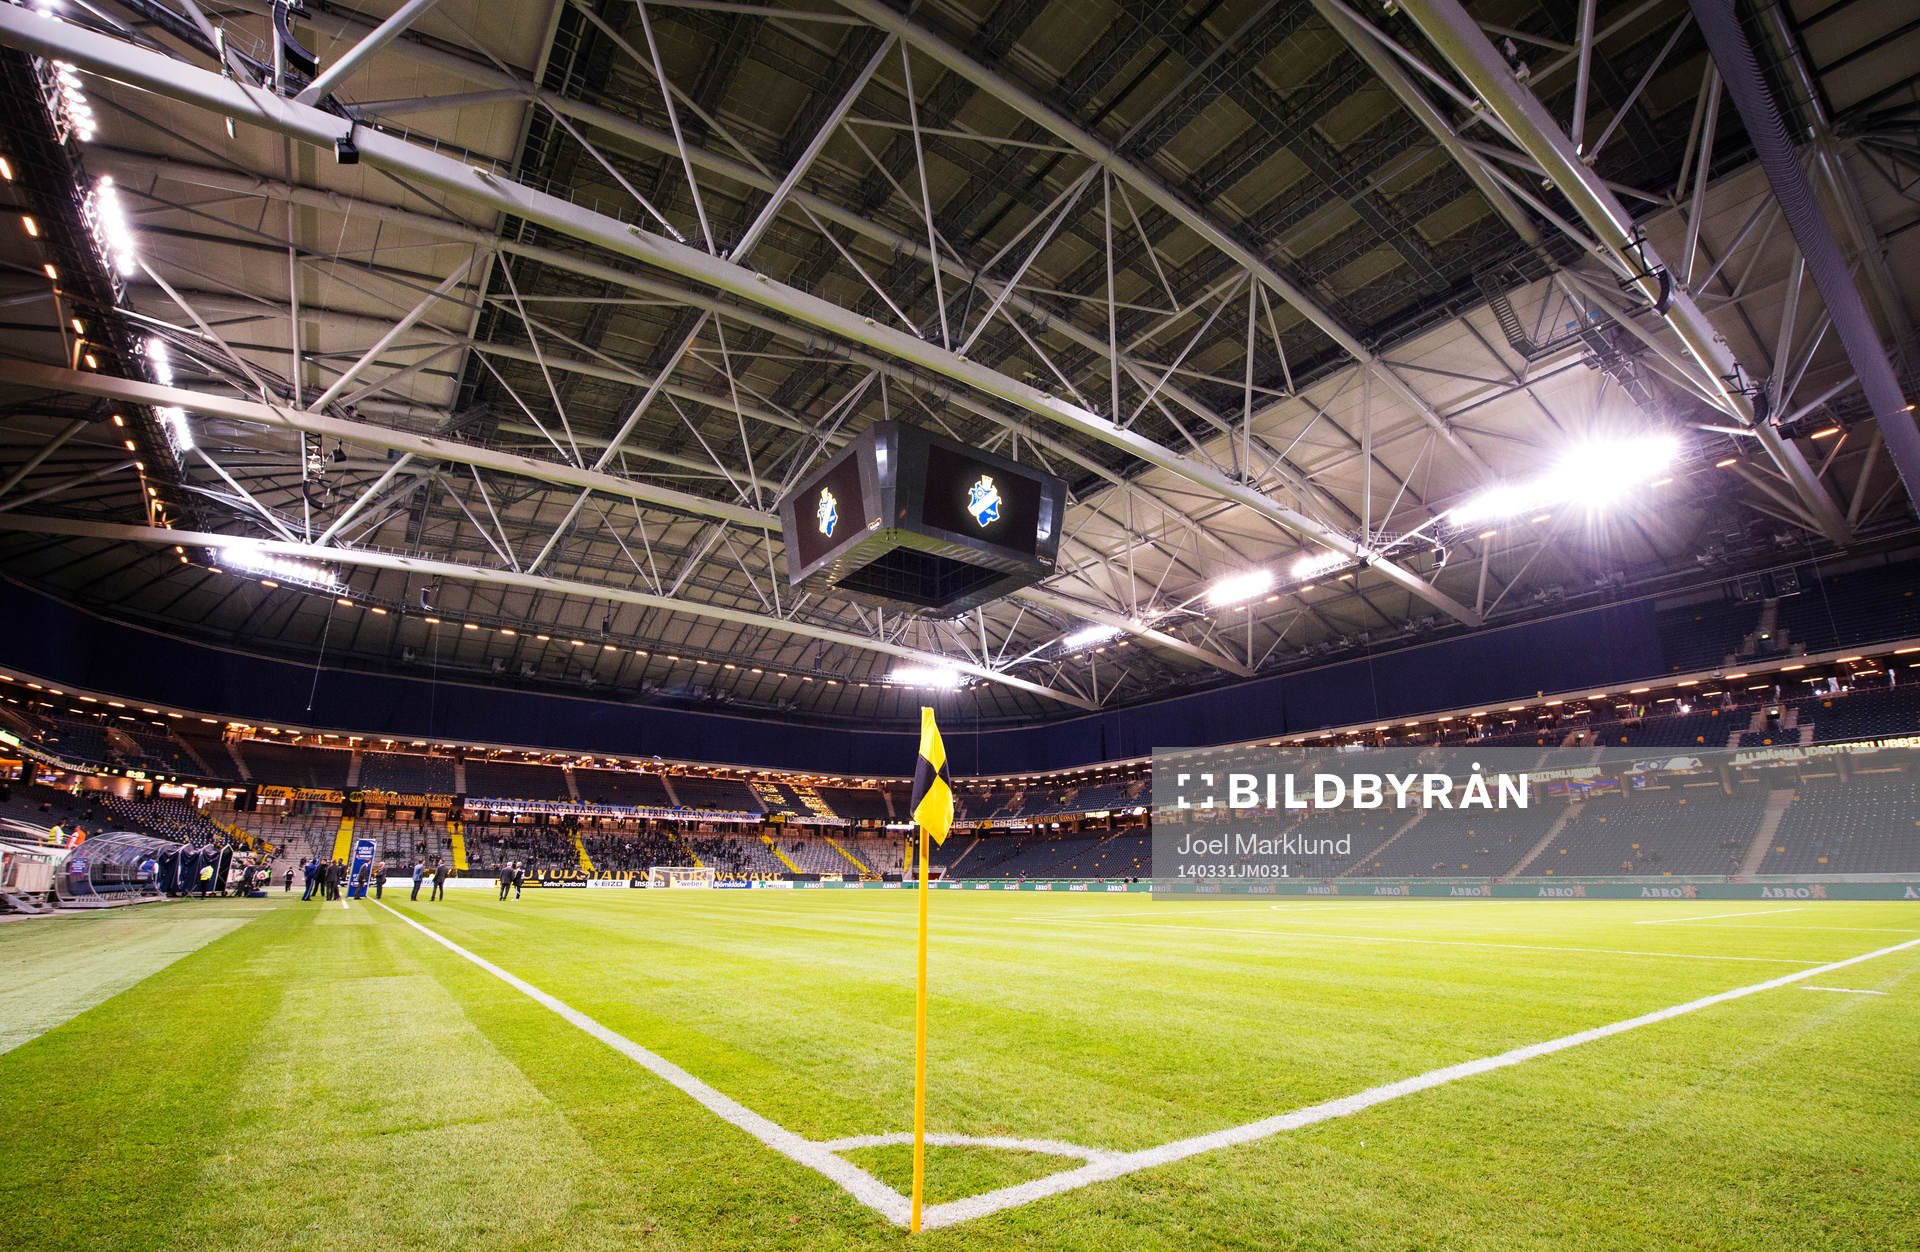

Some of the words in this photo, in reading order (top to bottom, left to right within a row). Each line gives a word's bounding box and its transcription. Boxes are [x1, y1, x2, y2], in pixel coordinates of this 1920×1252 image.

[1804, 736, 1920, 757] IDROTTSKLUBBE
[468, 799, 514, 810] SORGEN
[518, 802, 541, 812] HAR
[544, 803, 571, 813] INGA
[618, 807, 640, 816] VILA
[648, 808, 669, 818] FRID
